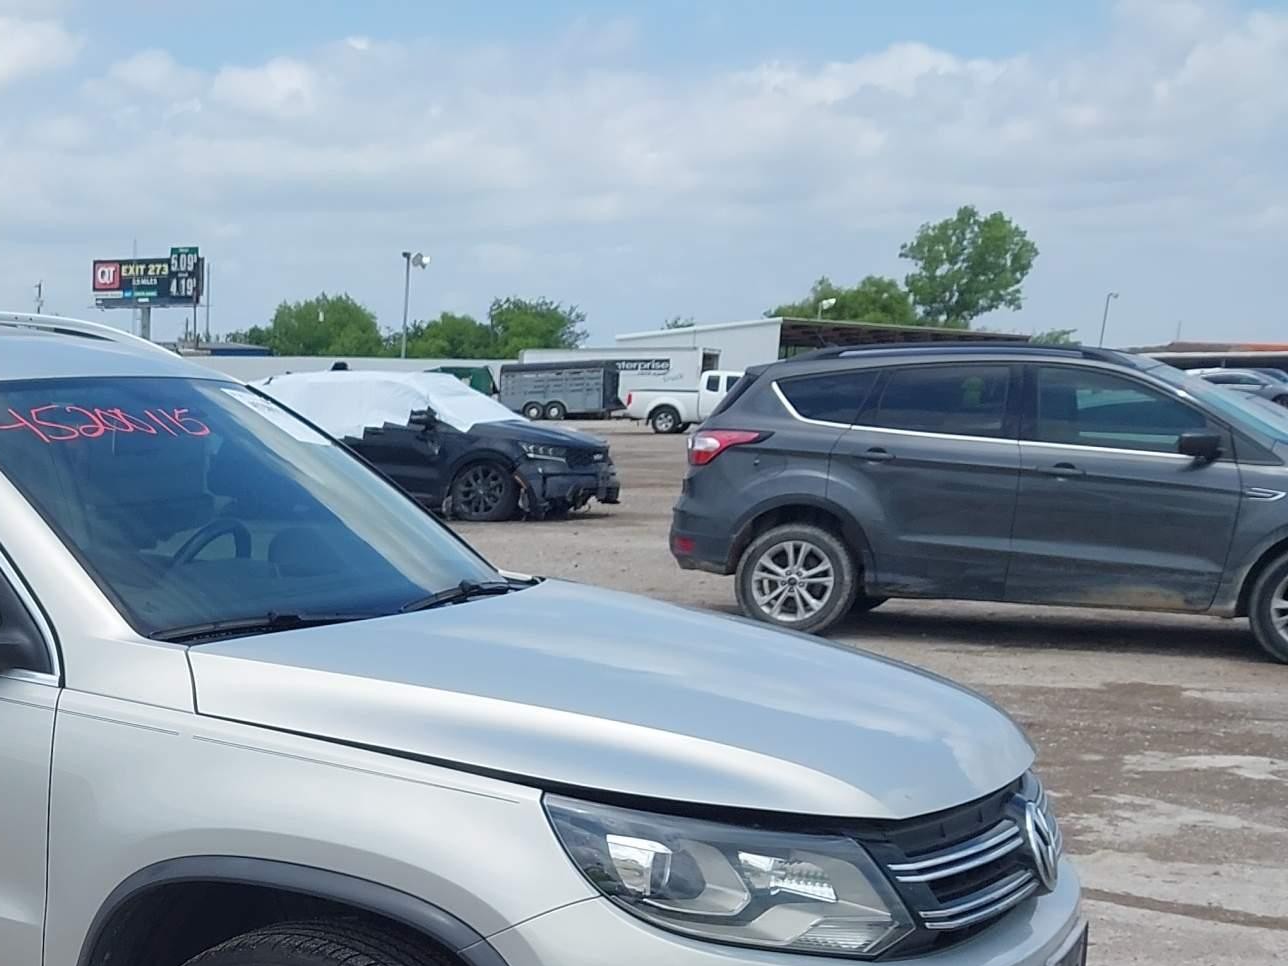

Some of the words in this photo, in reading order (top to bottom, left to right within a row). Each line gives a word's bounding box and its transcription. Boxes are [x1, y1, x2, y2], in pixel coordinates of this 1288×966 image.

[97, 266, 116, 285] QT
[121, 265, 147, 276] EXIT
[148, 263, 169, 276] 273
